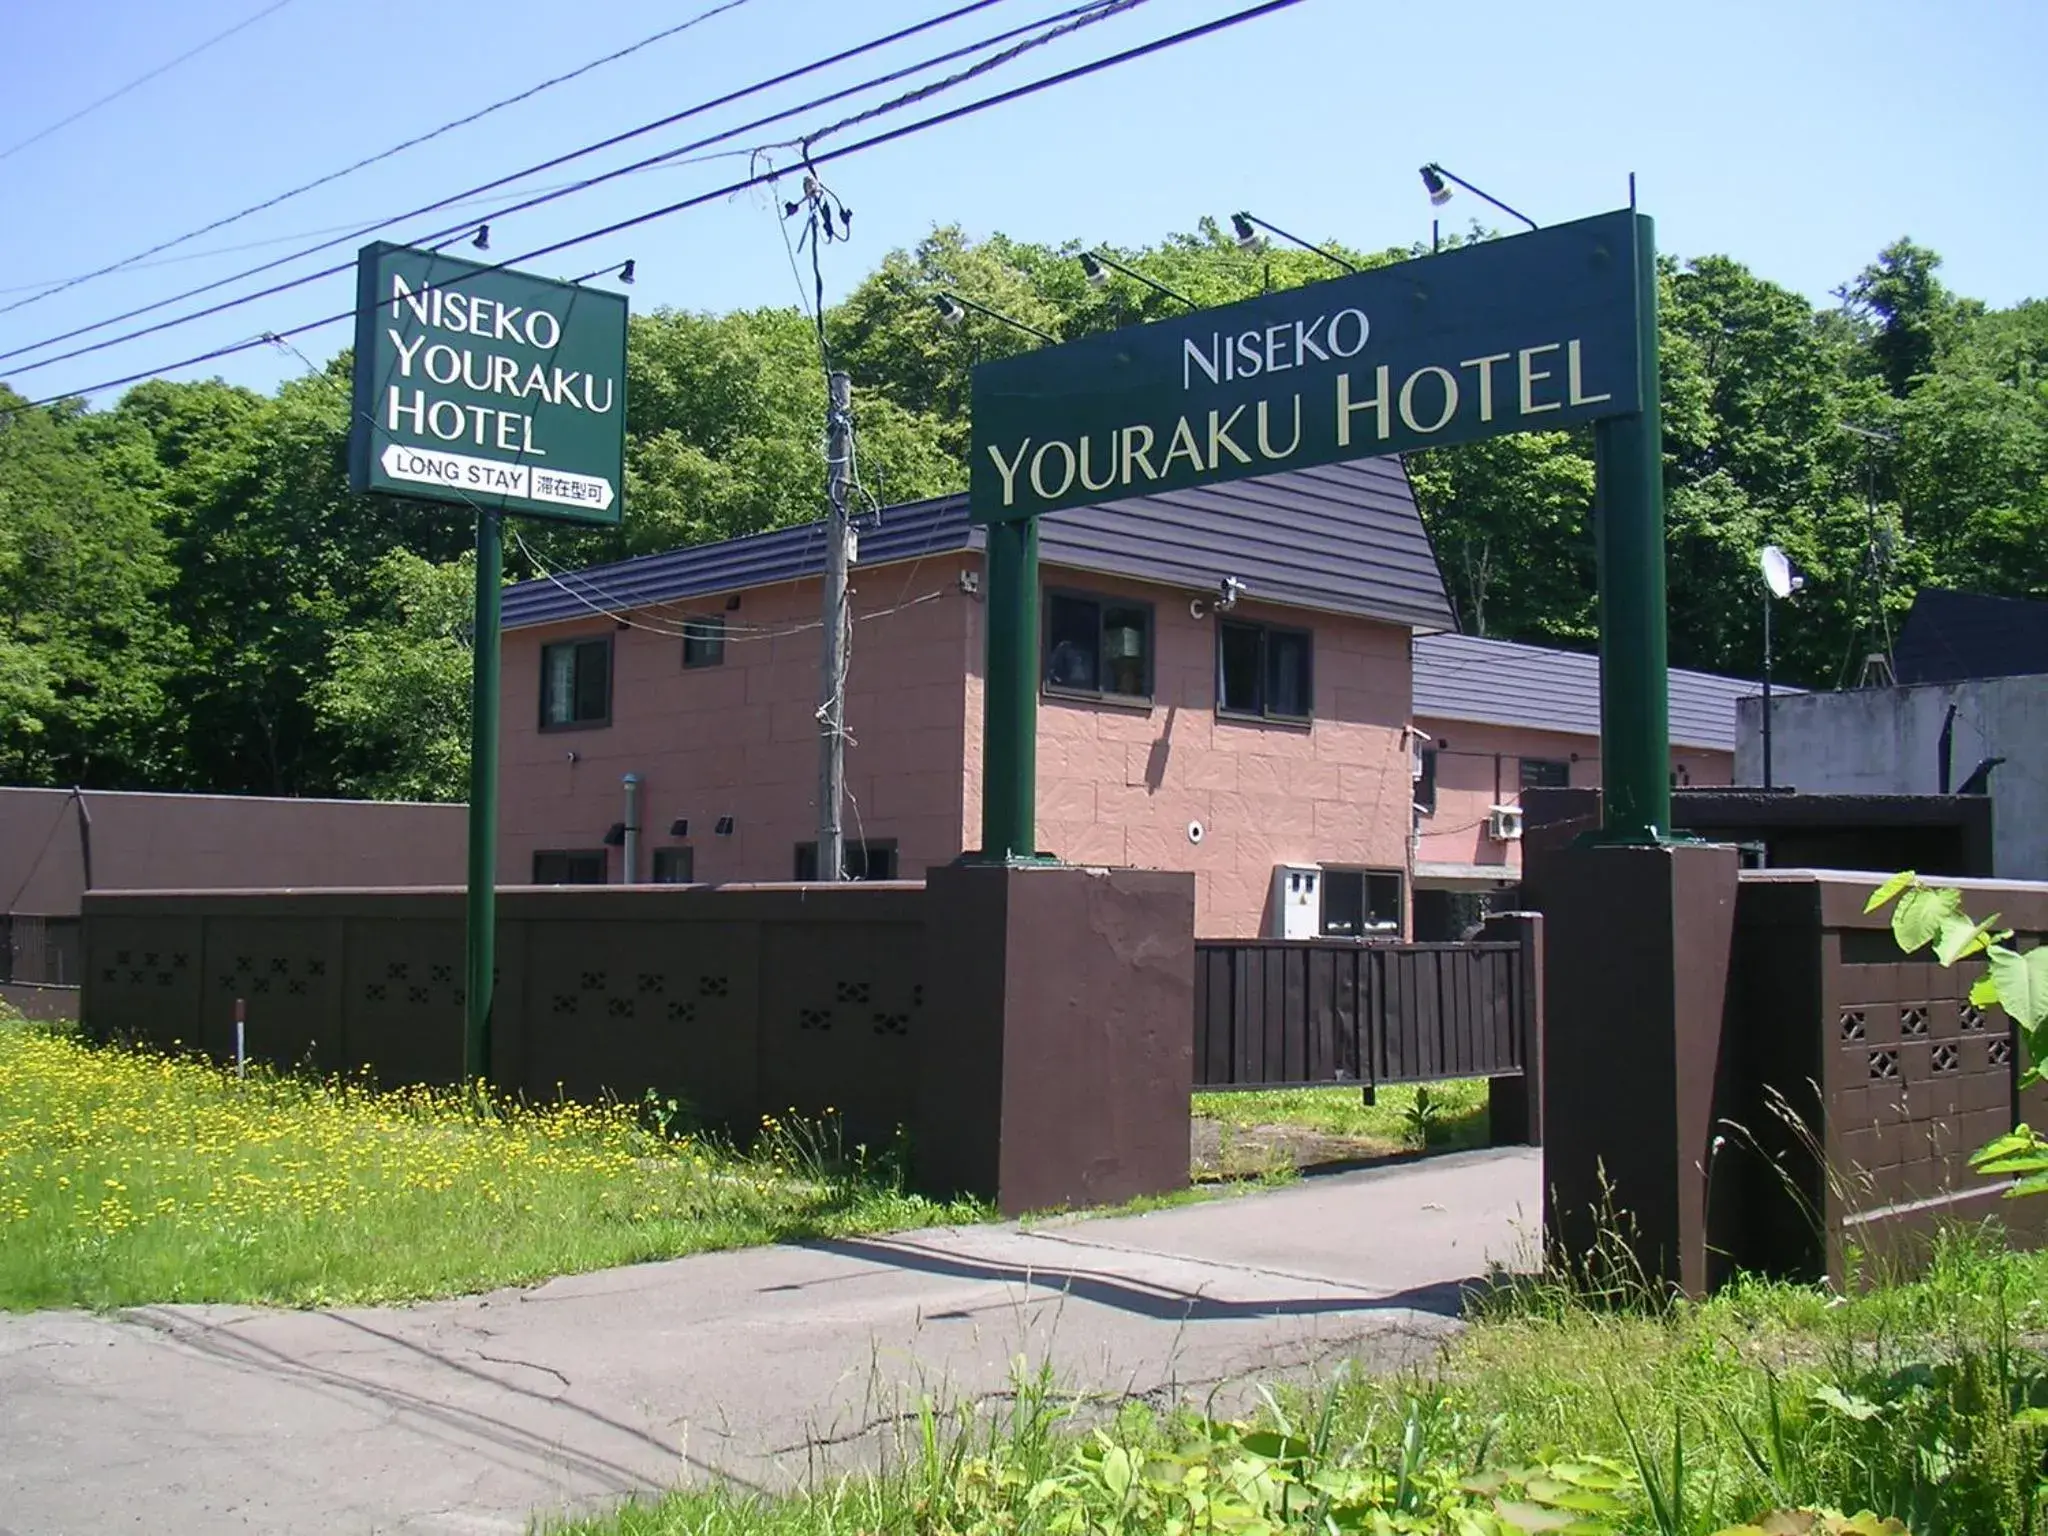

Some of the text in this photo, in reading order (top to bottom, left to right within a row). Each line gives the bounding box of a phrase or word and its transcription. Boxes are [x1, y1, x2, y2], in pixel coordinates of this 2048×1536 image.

[392, 273, 561, 350] NISEKO
[1183, 308, 1370, 391] NISEKO
[387, 328, 614, 413] YOURAKU
[388, 385, 547, 456] HOTEL
[987, 339, 1612, 506] YOURAKU HOTEL
[396, 453, 524, 490] LONG STAY
